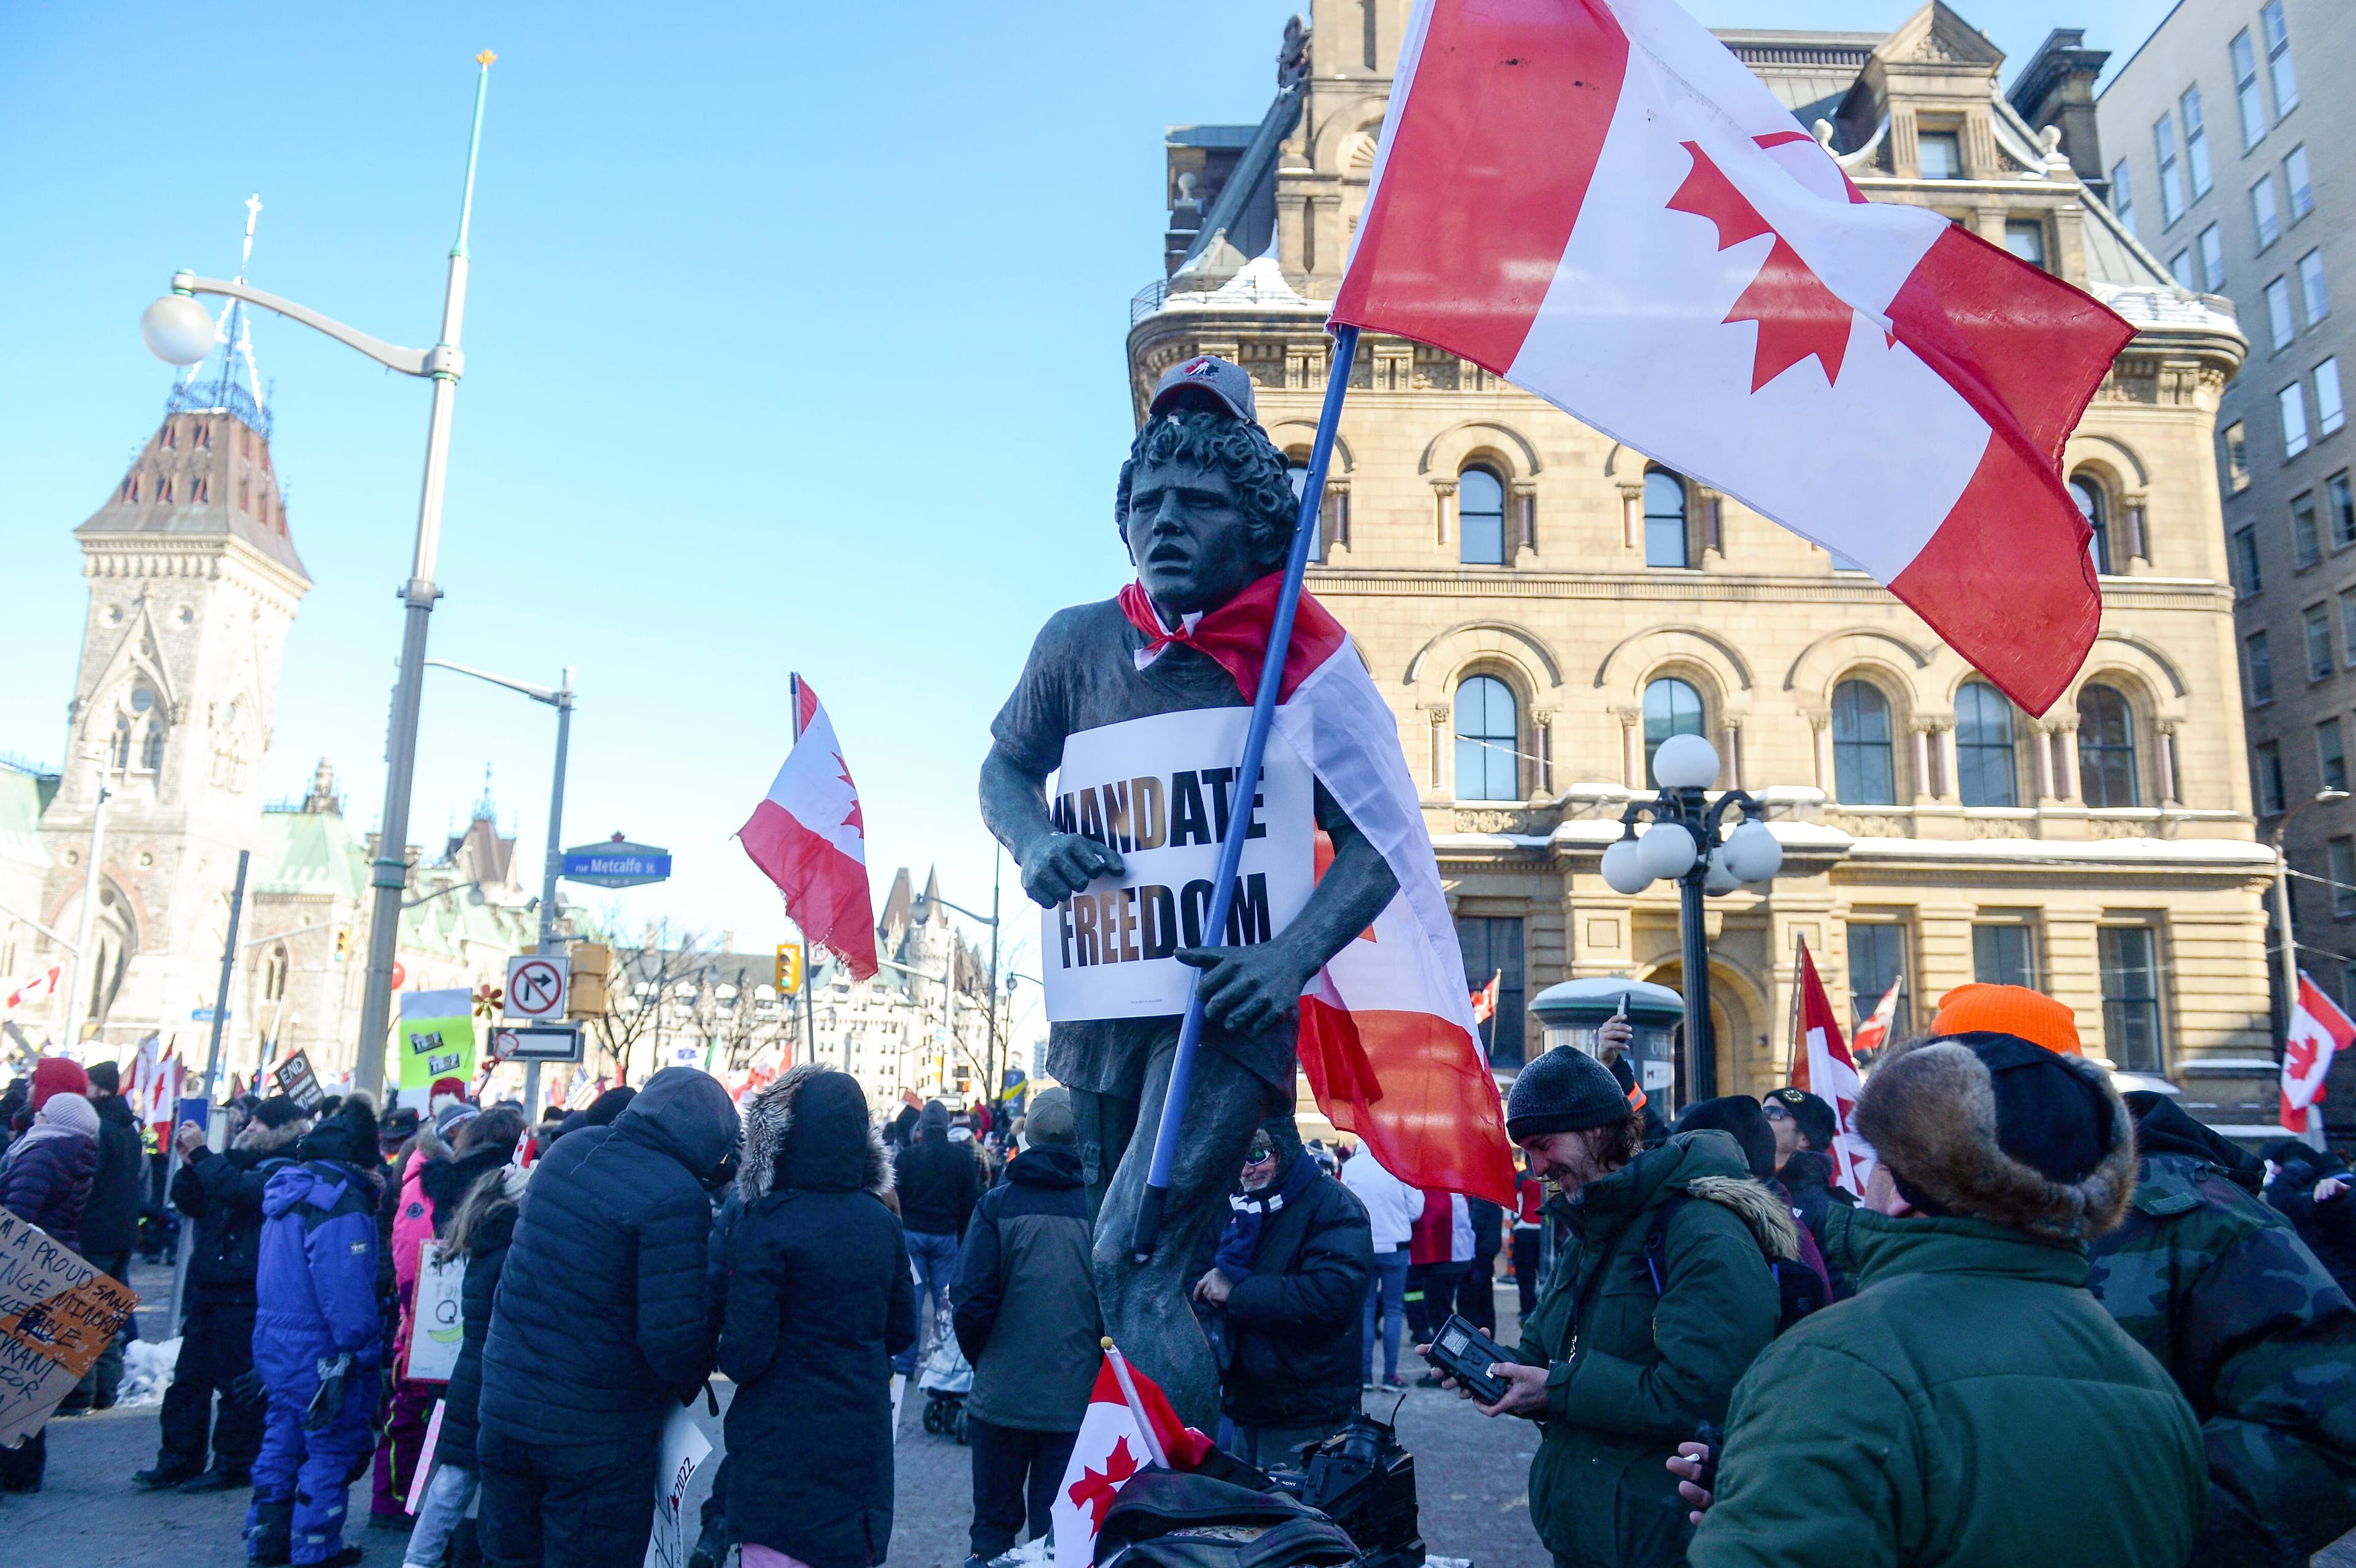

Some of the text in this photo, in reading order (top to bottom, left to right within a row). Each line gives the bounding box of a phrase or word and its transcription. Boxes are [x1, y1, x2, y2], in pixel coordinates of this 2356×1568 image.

[1054, 766, 1267, 855] MANDATE
[575, 864, 589, 874] rue
[590, 858, 642, 874] Metcalfe
[1058, 872, 1272, 969] FREEDOM
[280, 1056, 305, 1085] END
[0, 1251, 51, 1298] NGE
[13, 1229, 31, 1250] A
[31, 1241, 94, 1291] PROUD
[93, 1285, 136, 1316] SMALL
[675, 1456, 695, 1500] 2022
